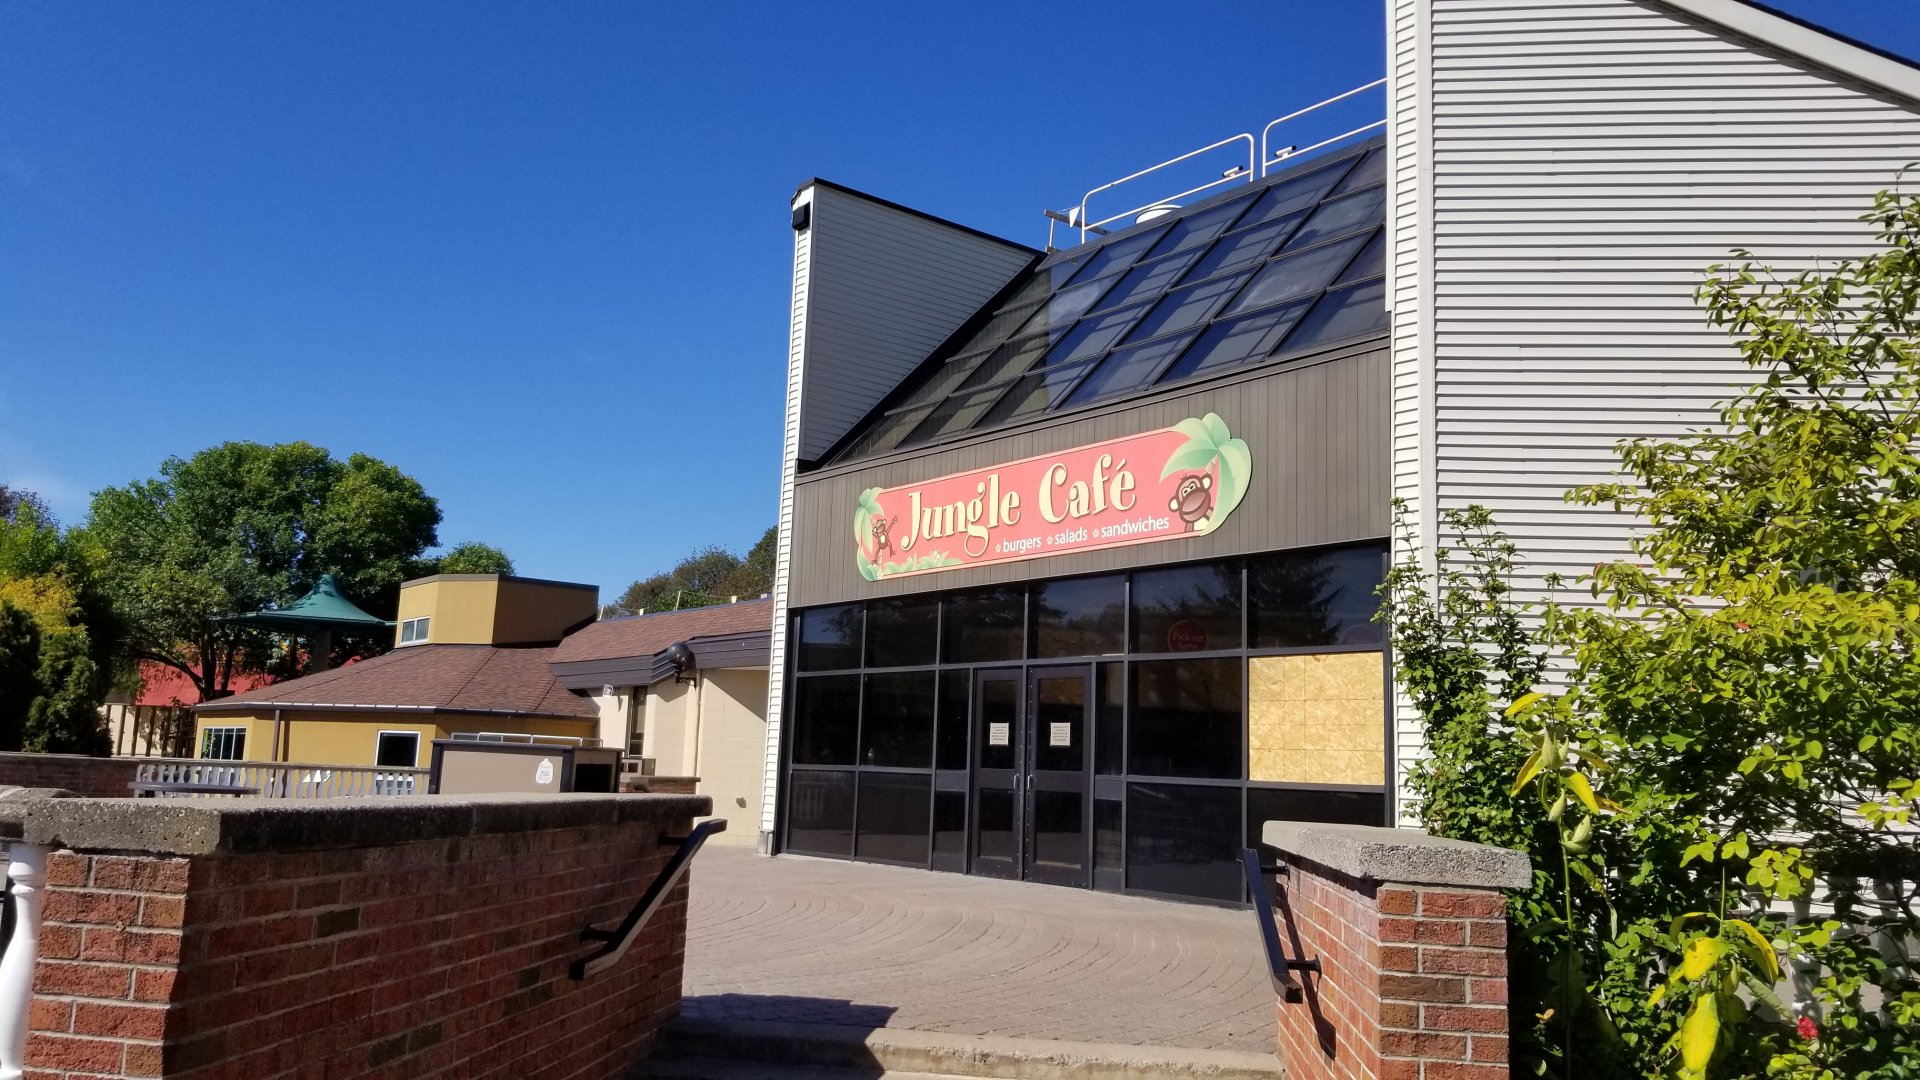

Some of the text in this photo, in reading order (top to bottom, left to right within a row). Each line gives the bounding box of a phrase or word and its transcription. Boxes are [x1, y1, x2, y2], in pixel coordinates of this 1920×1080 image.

[901, 453, 1136, 557] Jungle Café
[1003, 515, 1169, 554] burgers salads sandwiches
[1173, 632, 1190, 640] Pick
